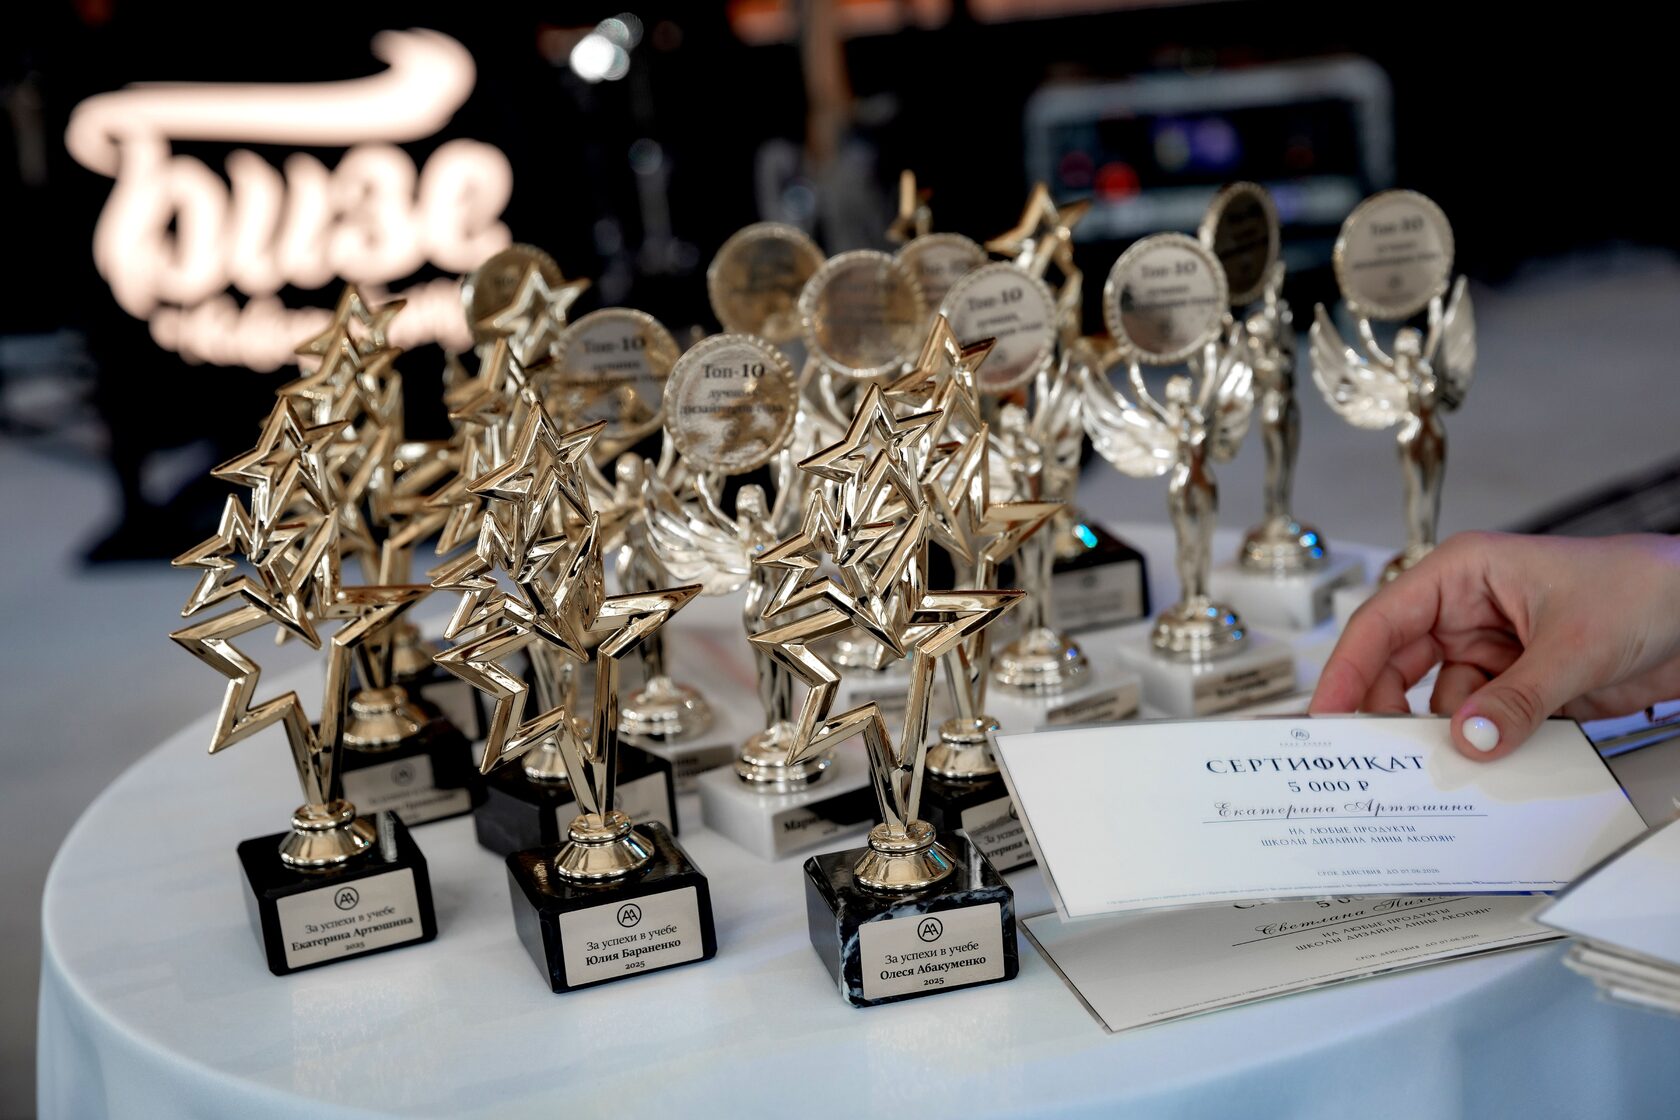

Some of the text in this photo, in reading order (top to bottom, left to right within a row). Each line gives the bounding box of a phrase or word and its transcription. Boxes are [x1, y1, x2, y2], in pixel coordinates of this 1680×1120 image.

[704, 363, 766, 378] Топ-10
[1206, 755, 1424, 774] СЕРТИФИКАТ
[1288, 780, 1301, 793] 5
[1308, 780, 1350, 792] 000
[1214, 798, 1474, 819] Екатерина Артюшина
[1261, 837, 1307, 846] ШКОЛЫ
[1370, 835, 1402, 843] АННЫ
[1288, 825, 1416, 836] НА ЛЮБЫЕ ПРОДУКТЫ
[305, 906, 396, 934] За успехи в учебе
[1255, 910, 1366, 935] Светлана
[1322, 908, 1451, 938] НА ЛЮБЫЕ ПРОДУКТЫ
[291, 916, 414, 952] Екатерина Артюшина
[586, 925, 678, 951] За успехи в учебе
[1296, 937, 1342, 951] ШКОЛЫ
[1405, 918, 1438, 930] АННЫ
[345, 941, 365, 951] 2025
[585, 940, 681, 966] Юлия Бараненко
[885, 941, 979, 965] За успехи в учебе
[625, 961, 646, 970] 2025
[880, 956, 987, 980] Олеся Абакуменко
[923, 977, 945, 986] 2025
